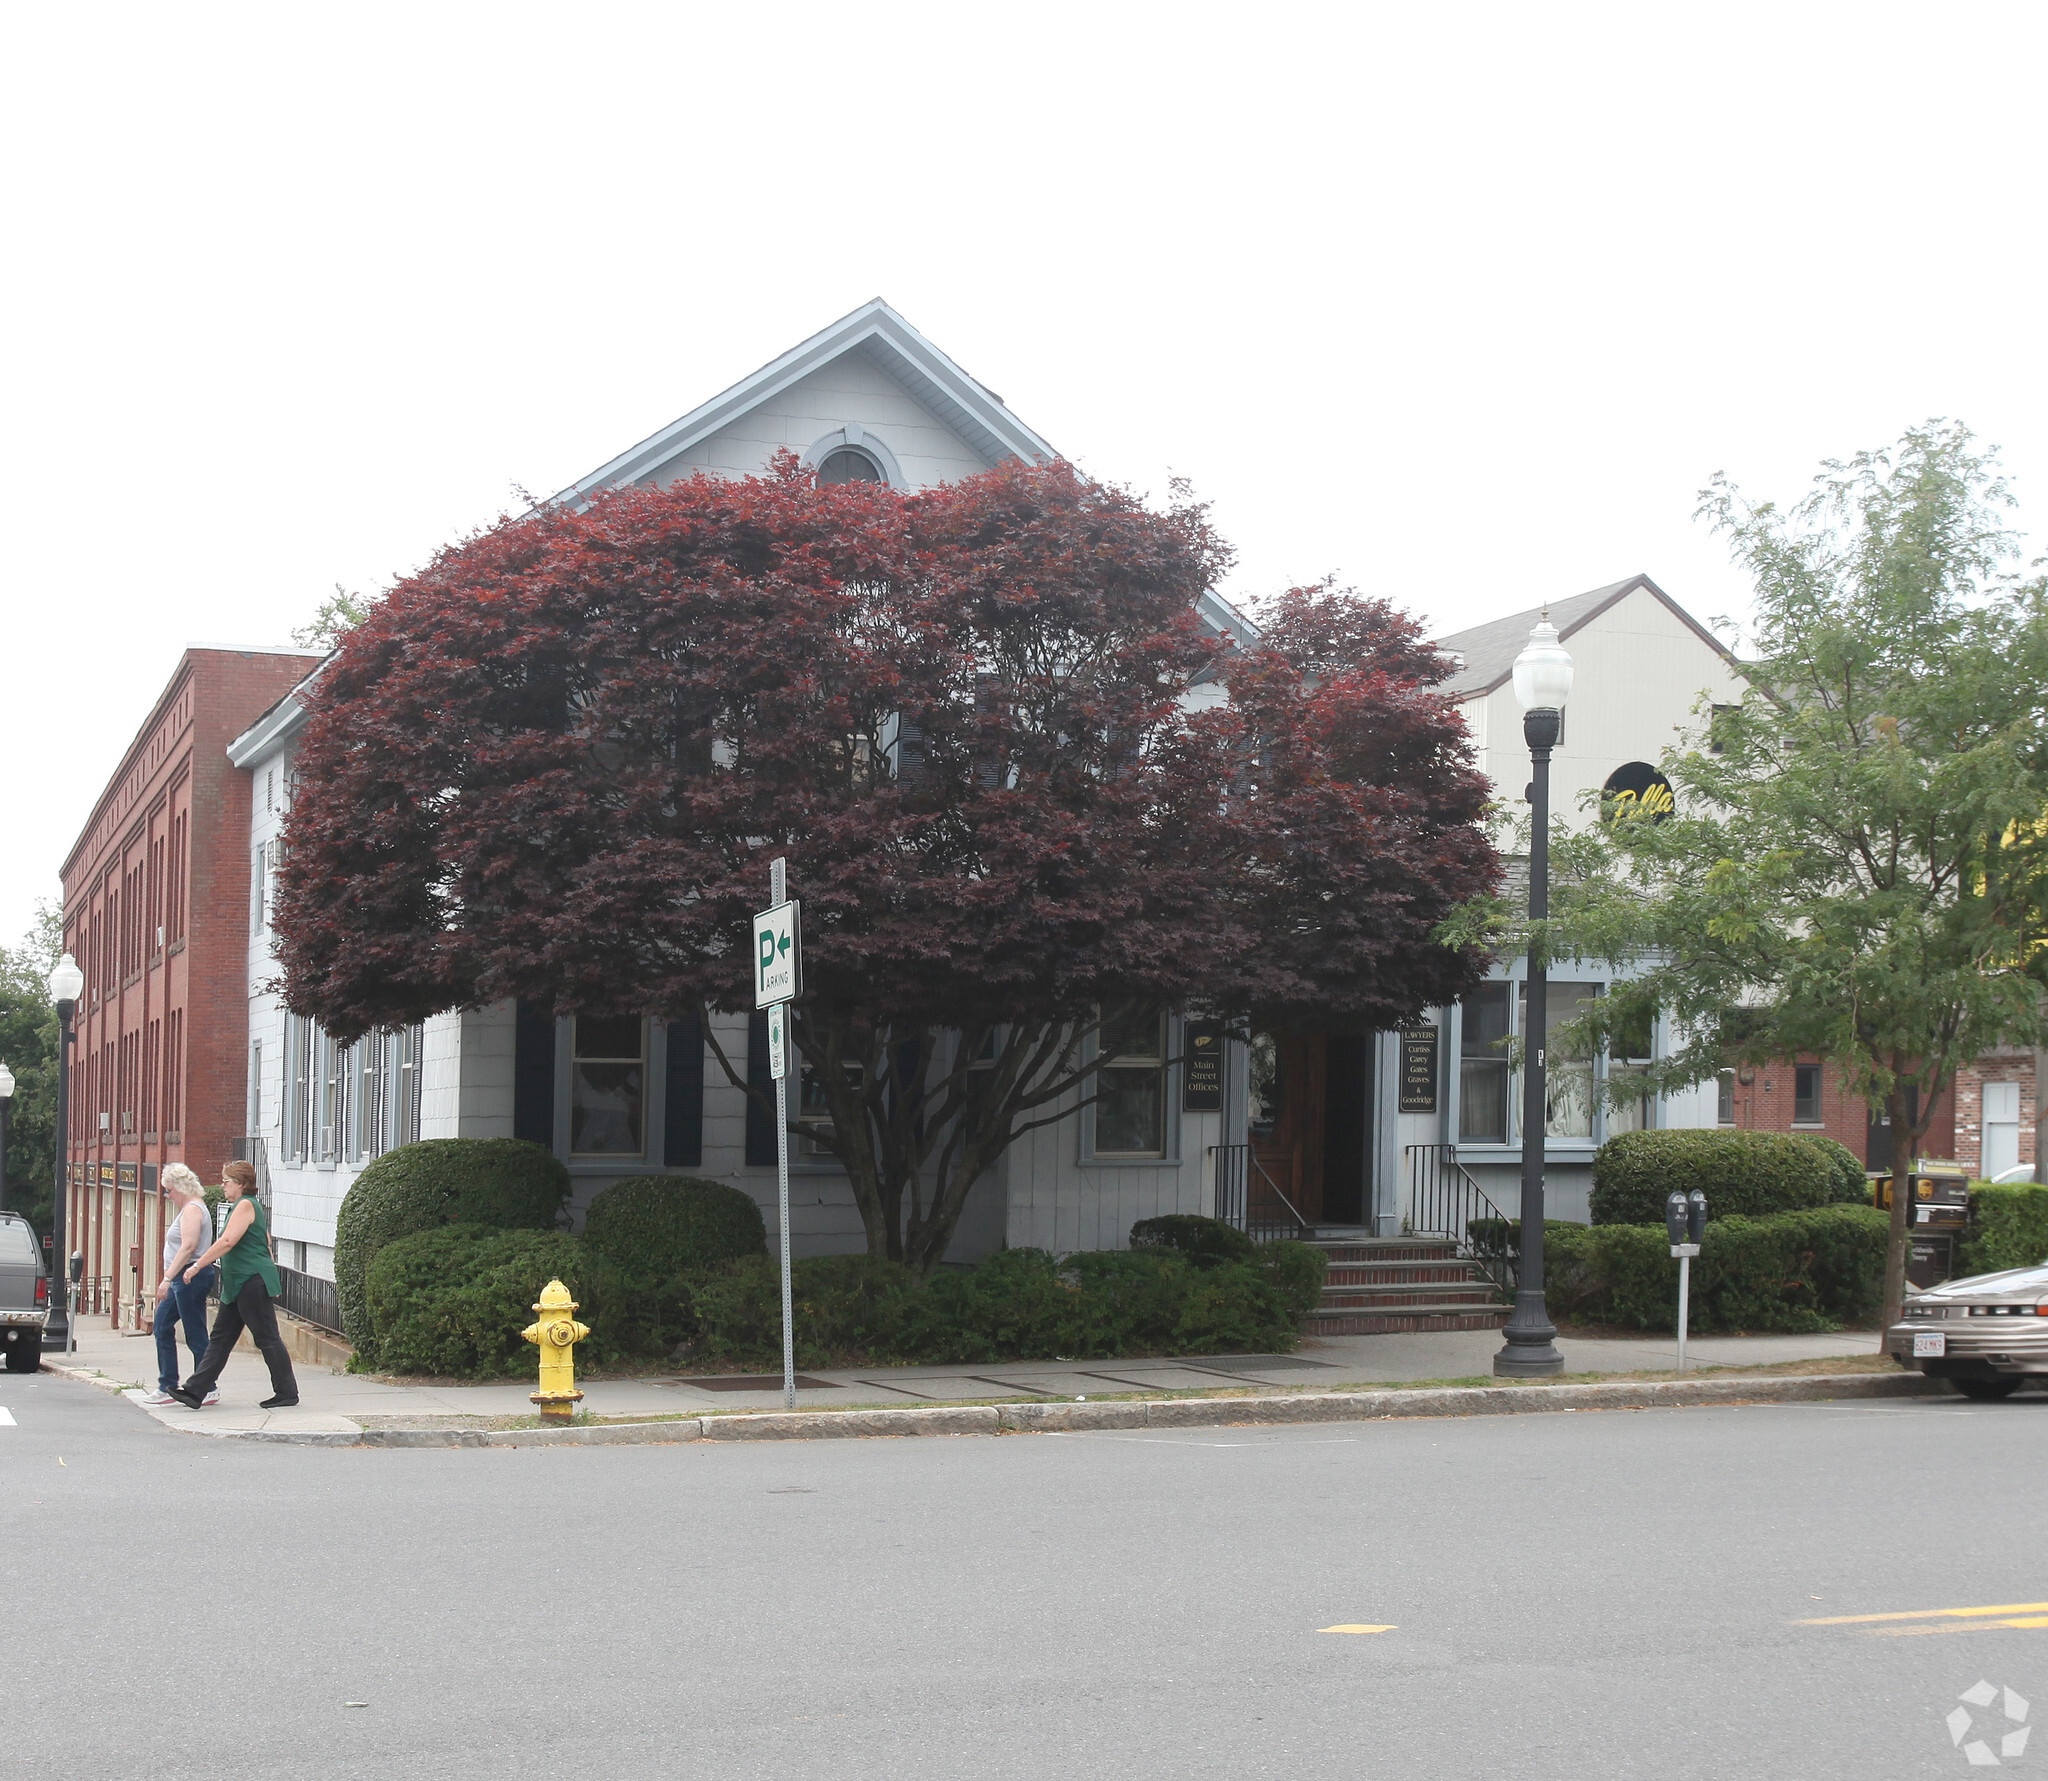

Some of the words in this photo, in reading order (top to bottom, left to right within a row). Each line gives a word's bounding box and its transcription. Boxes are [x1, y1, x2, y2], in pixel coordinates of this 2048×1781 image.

[760, 929, 789, 992] PARKING
[1404, 1031, 1435, 1039] LAWYERS
[1408, 1045, 1431, 1053] Curtiss
[1194, 1061, 1214, 1069] Main
[1191, 1072, 1216, 1080] Street
[1407, 1075, 1430, 1084] Graves
[1188, 1082, 1219, 1091] Offices
[1416, 1086, 1421, 1094] &
